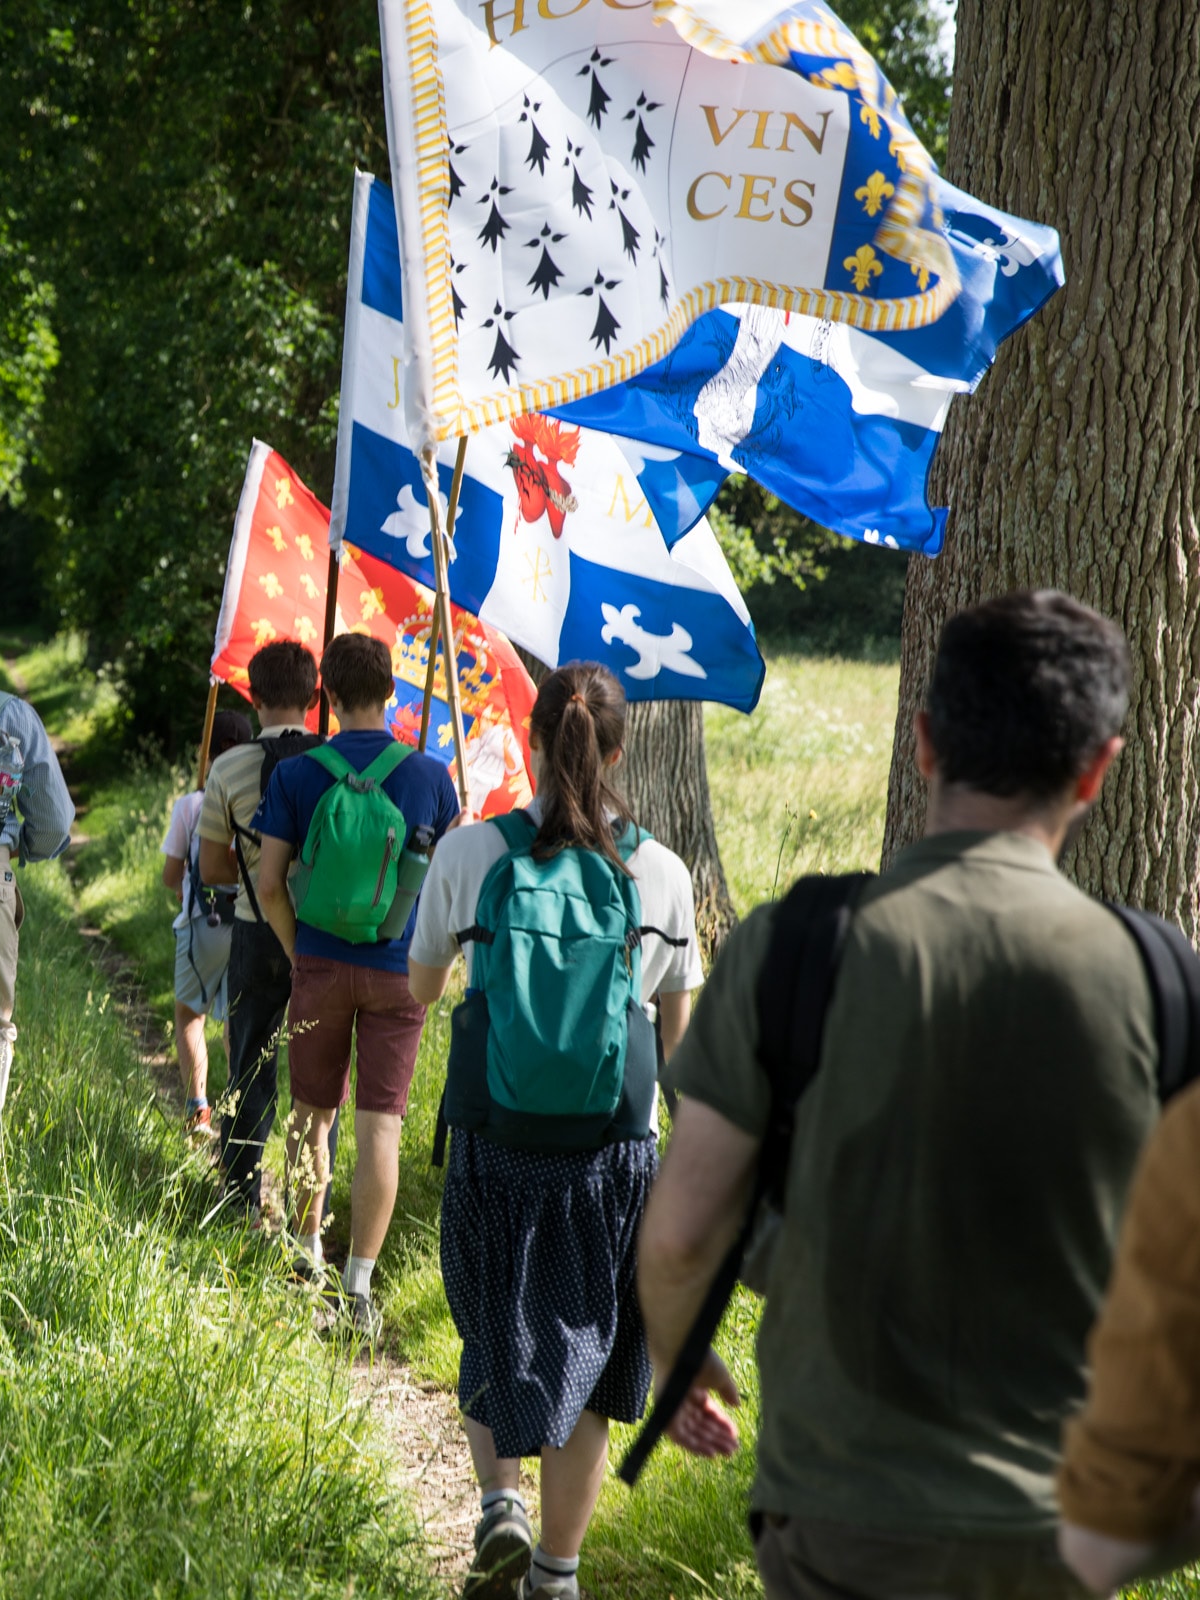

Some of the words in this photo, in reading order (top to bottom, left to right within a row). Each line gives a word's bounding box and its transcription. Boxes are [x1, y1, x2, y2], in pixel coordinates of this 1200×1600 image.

[699, 104, 834, 155] VIN
[686, 171, 816, 227] CES
[603, 473, 654, 528] M
